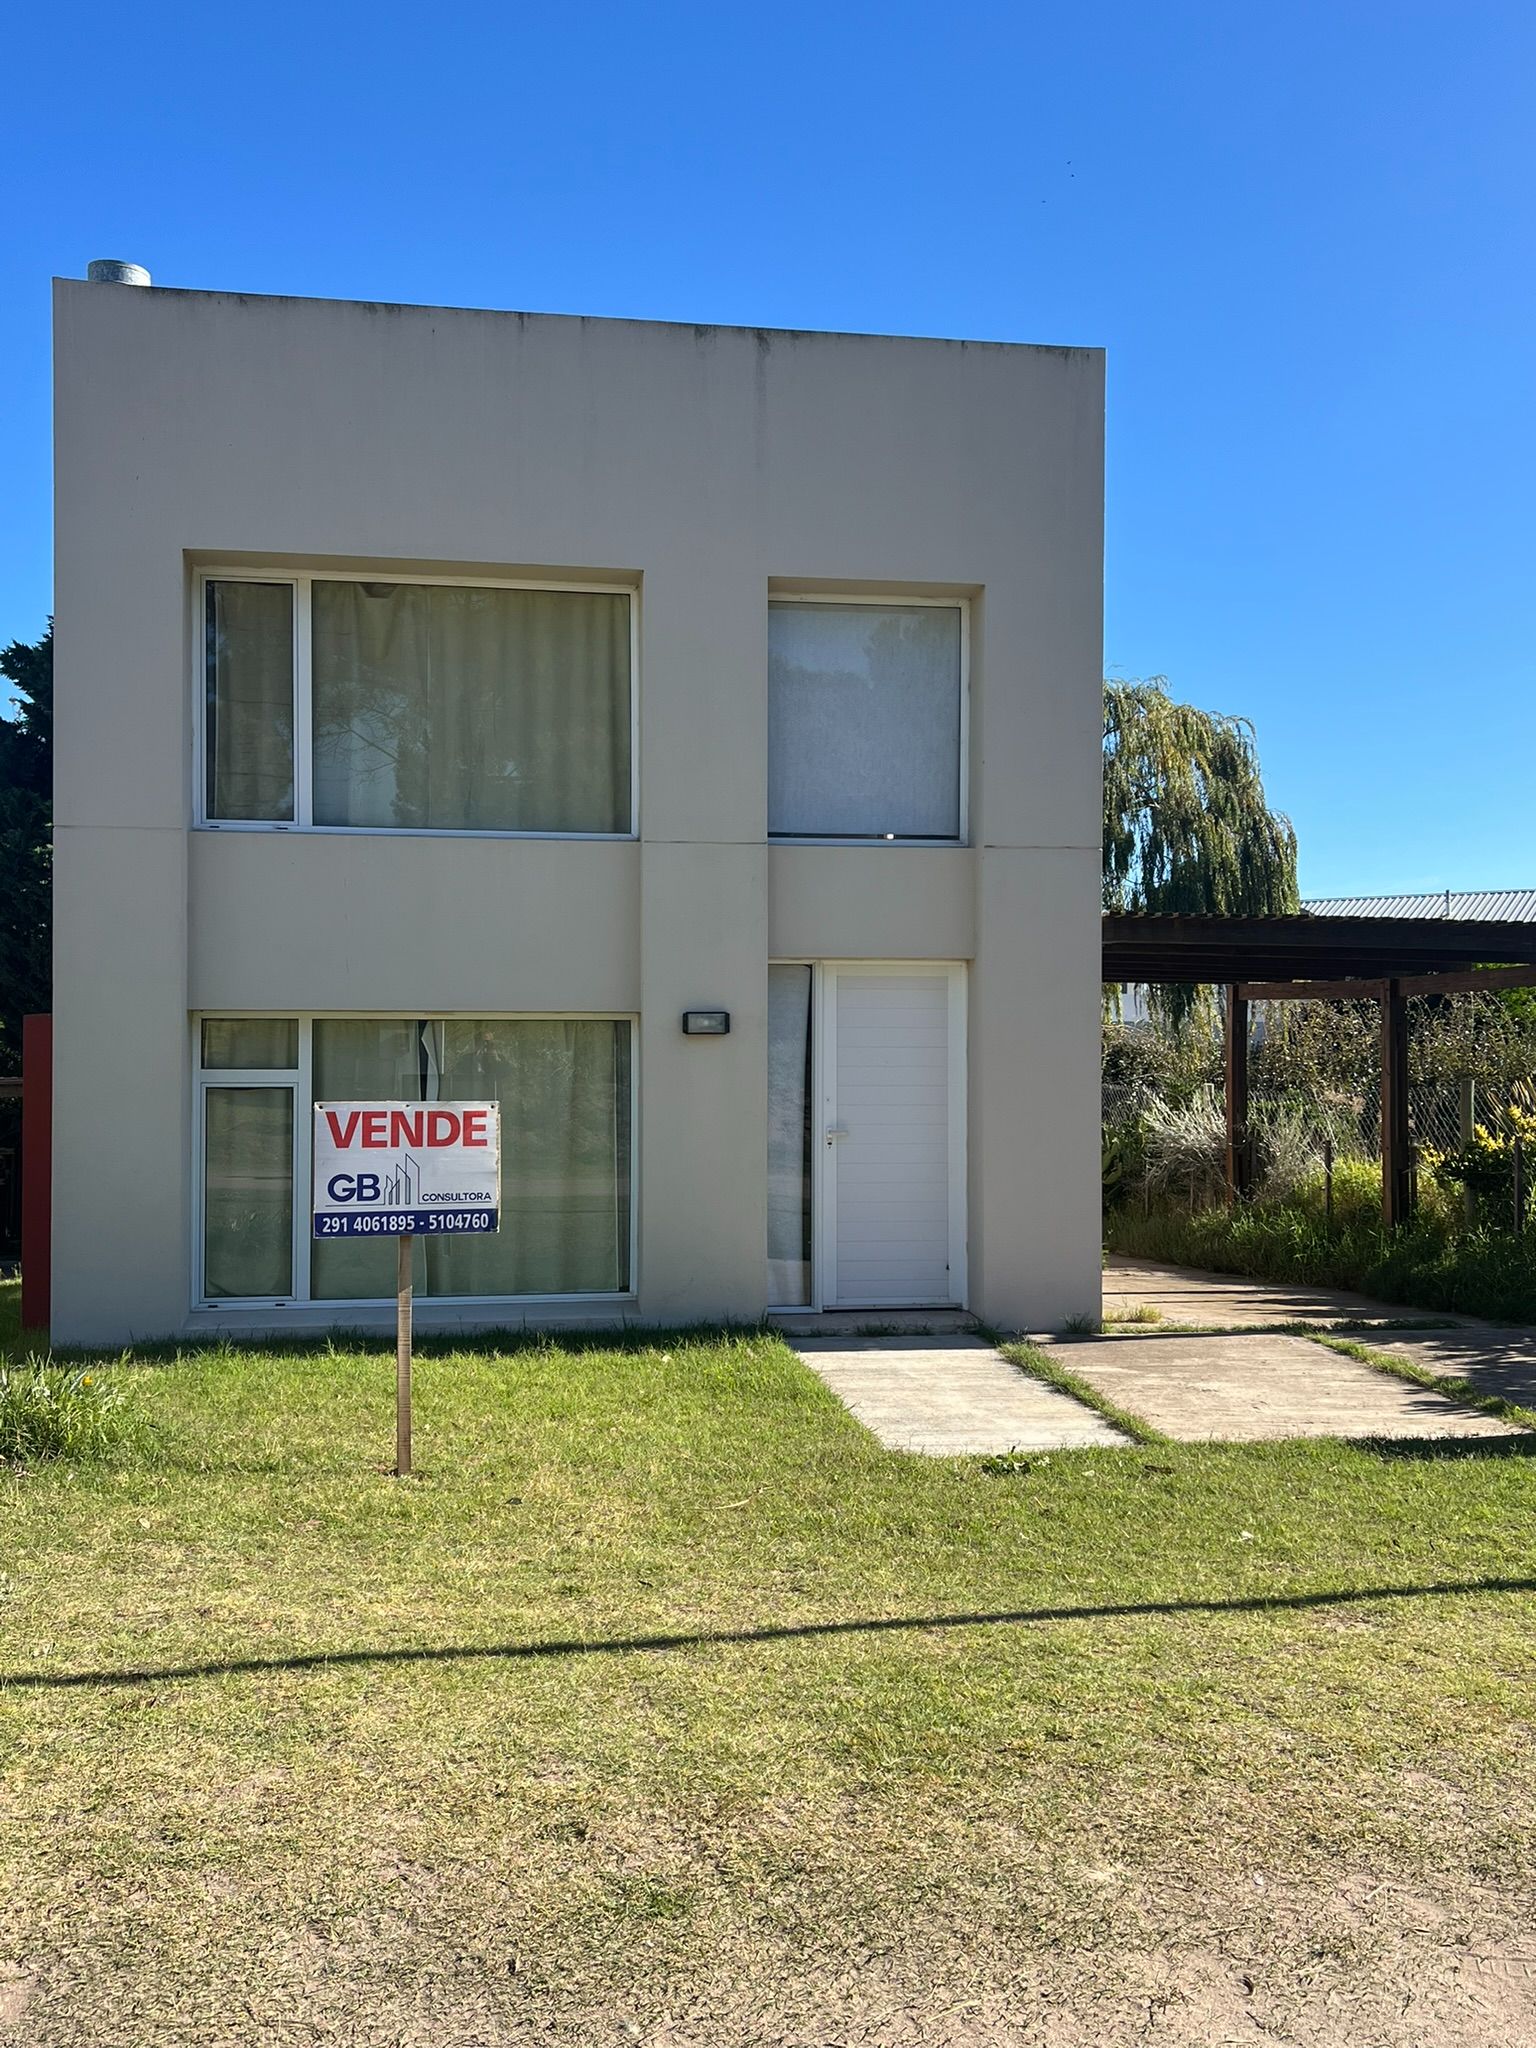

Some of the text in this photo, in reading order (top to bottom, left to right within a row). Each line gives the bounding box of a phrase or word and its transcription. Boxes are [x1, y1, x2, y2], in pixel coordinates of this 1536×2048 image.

[325, 1111, 488, 1148] VENDE
[327, 1173, 381, 1202] GB
[422, 1192, 492, 1202] CONSULTORA
[322, 1217, 348, 1233] 291
[353, 1215, 415, 1232] 4061895
[429, 1213, 489, 1230] 5104760
